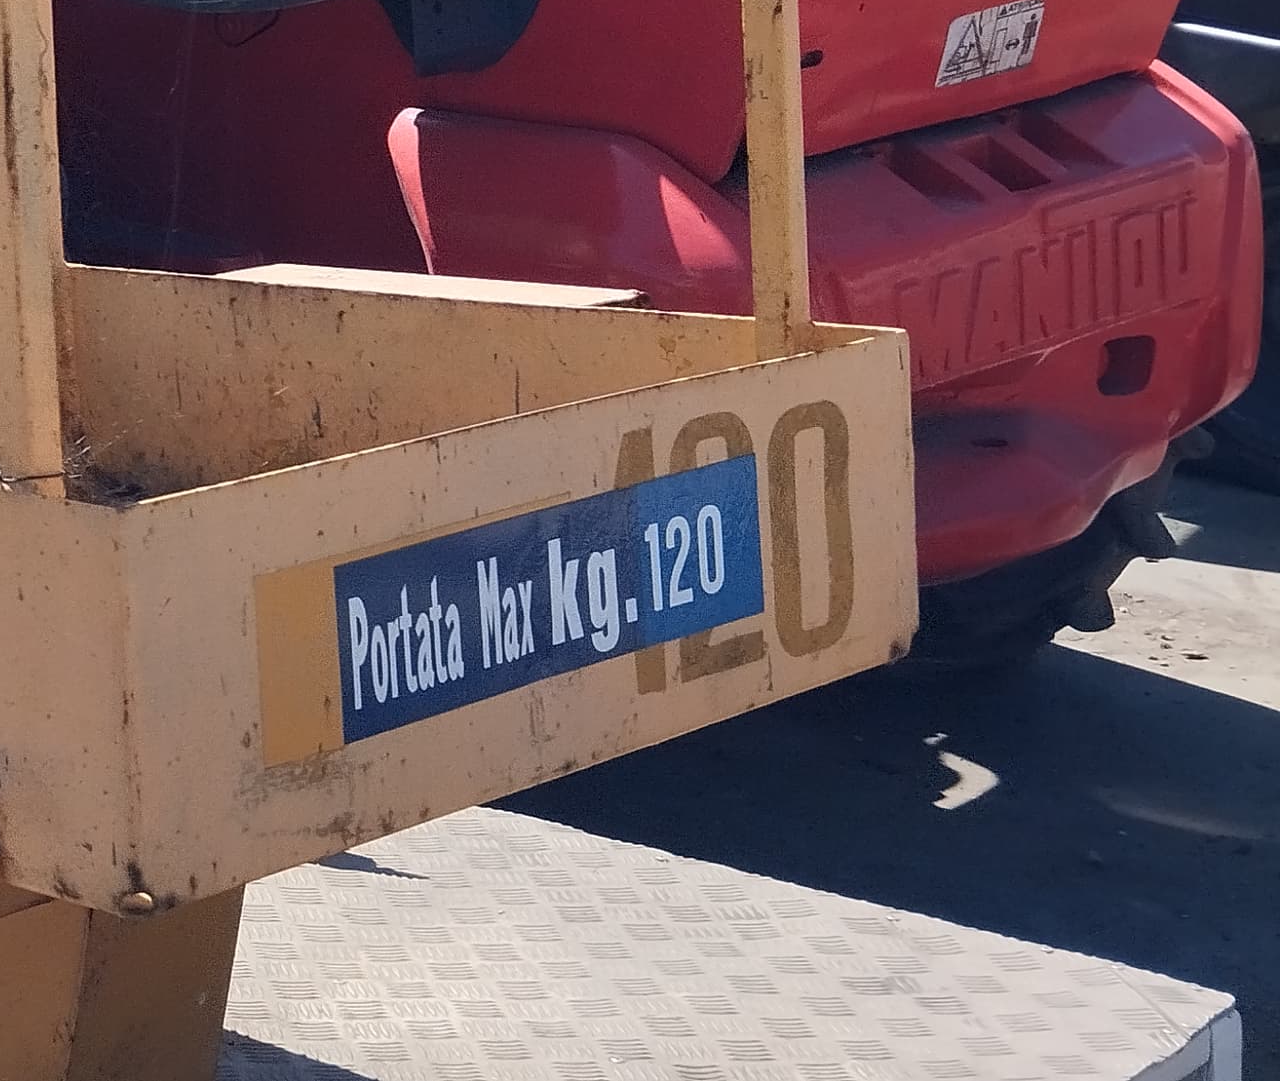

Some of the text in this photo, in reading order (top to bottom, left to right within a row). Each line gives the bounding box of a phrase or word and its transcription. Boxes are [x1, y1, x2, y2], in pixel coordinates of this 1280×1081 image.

[348, 504, 725, 710] Portata Max kg. 120
